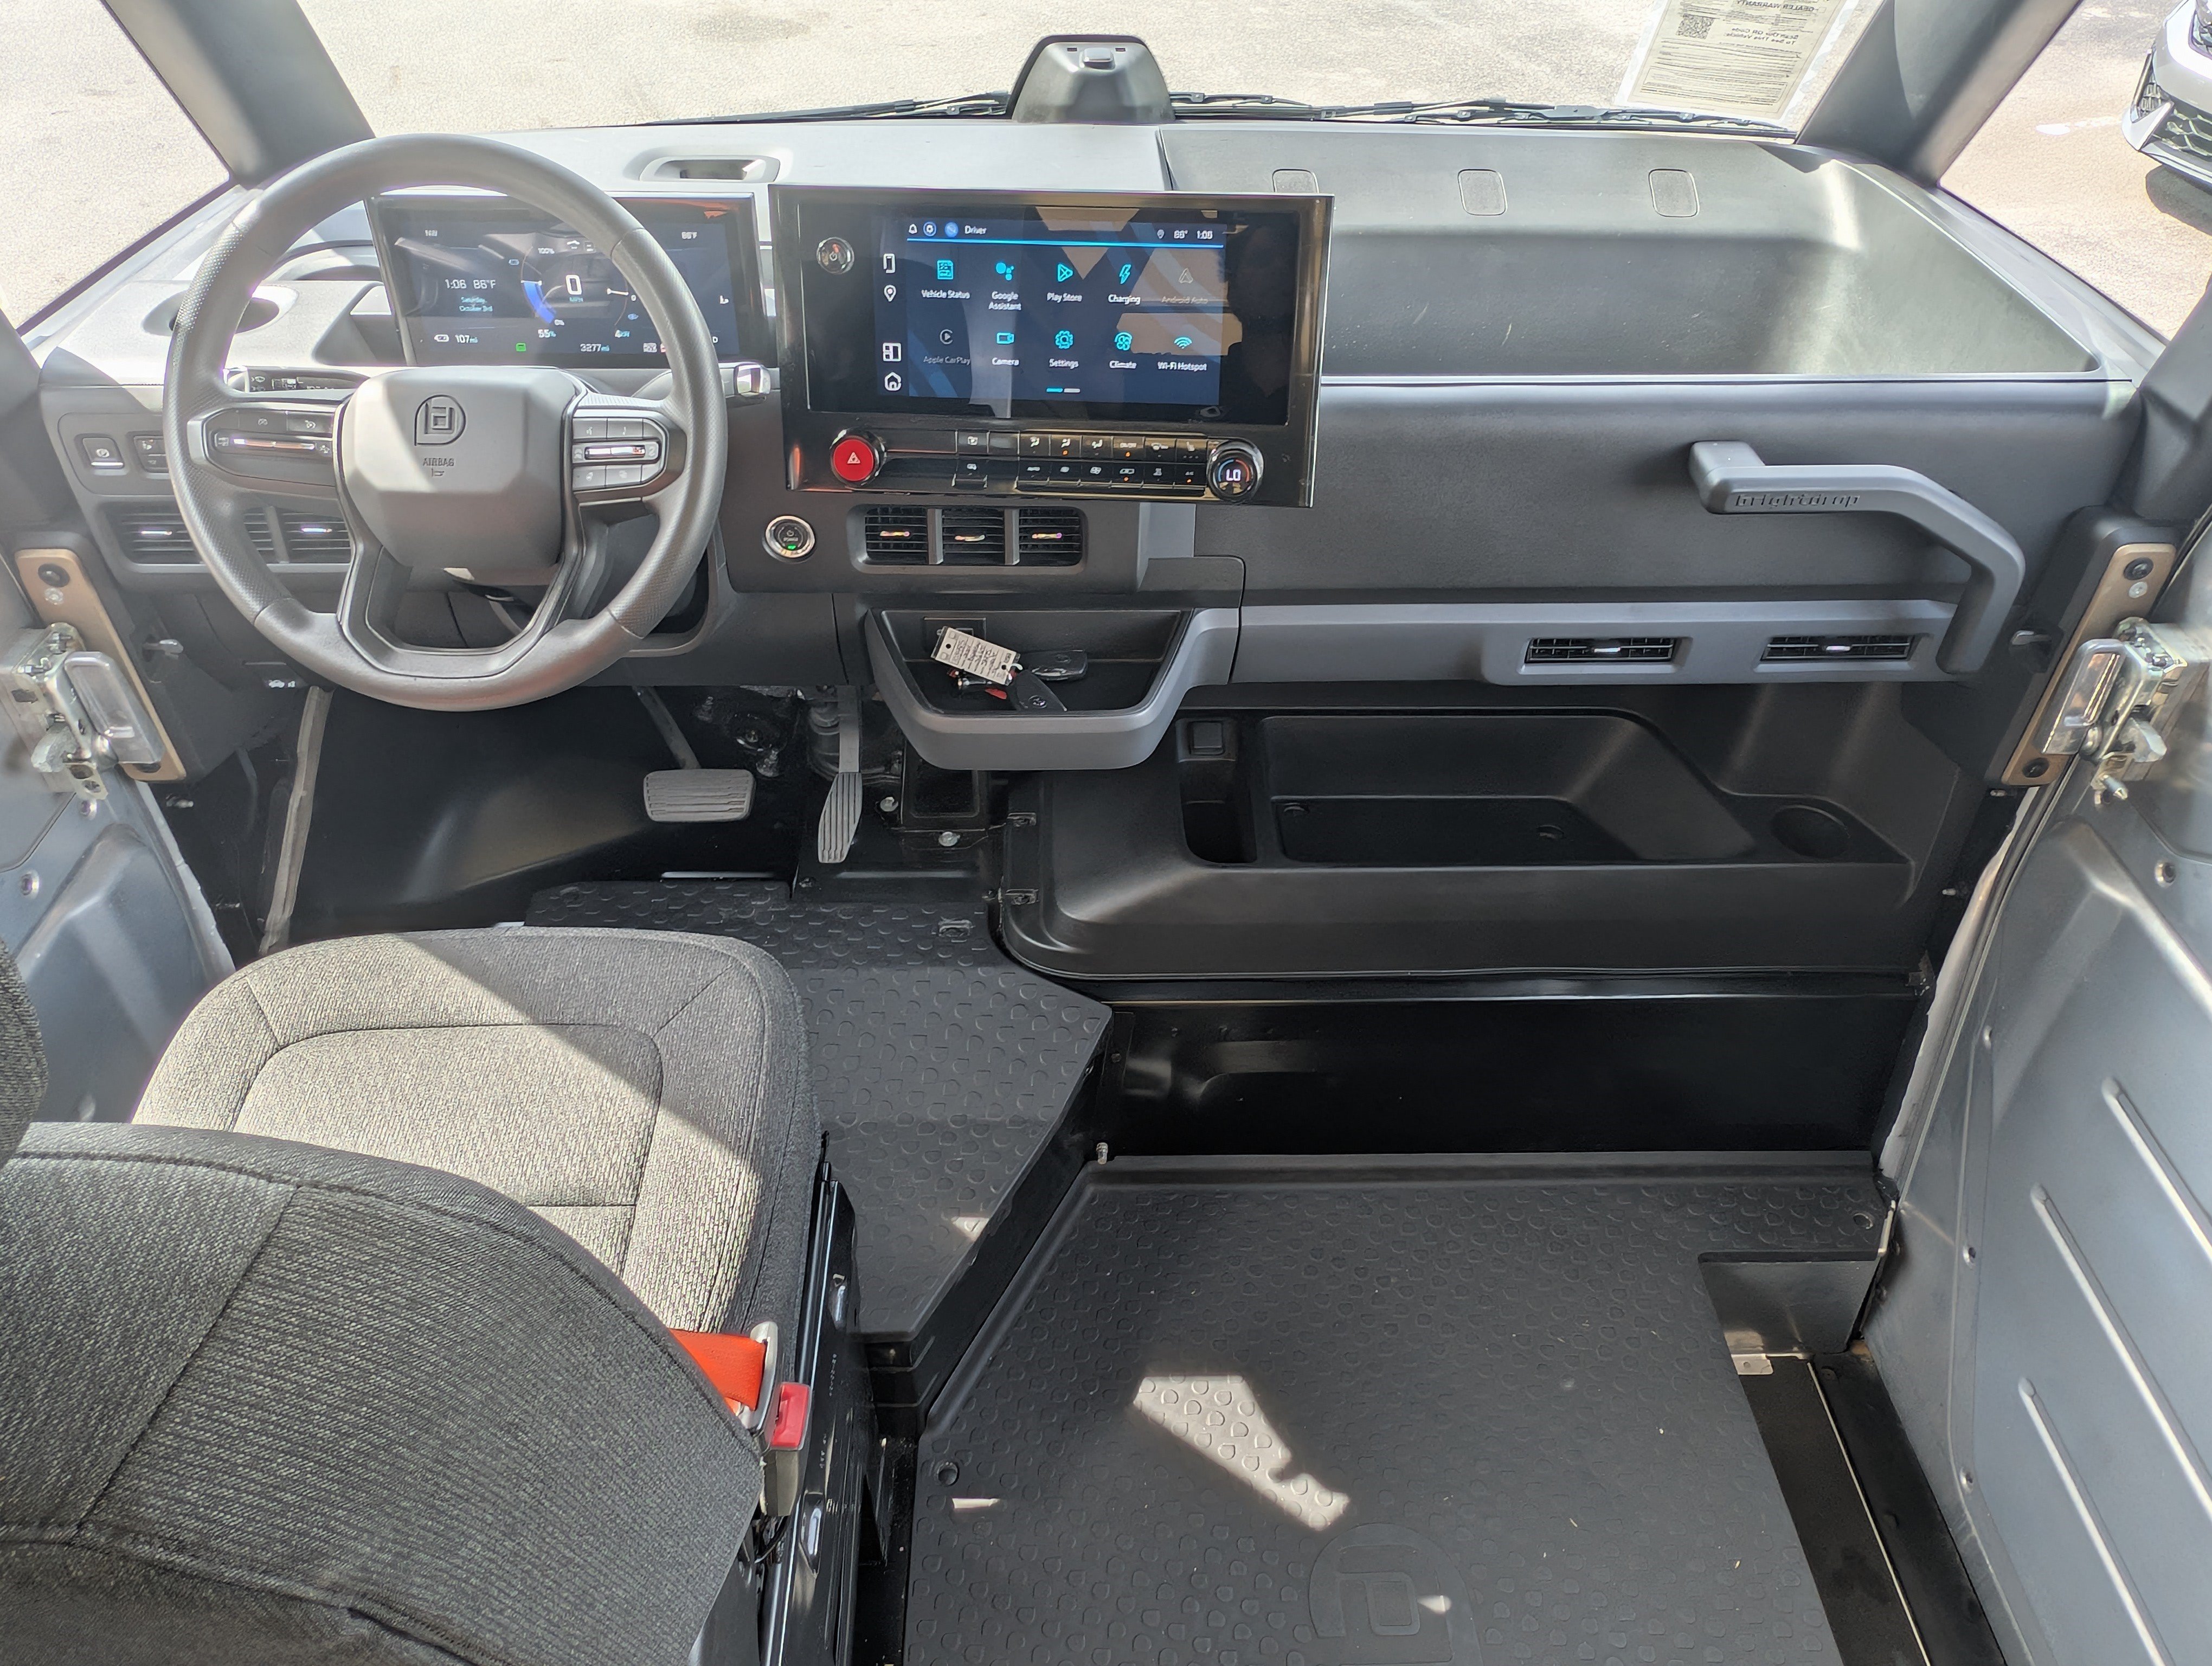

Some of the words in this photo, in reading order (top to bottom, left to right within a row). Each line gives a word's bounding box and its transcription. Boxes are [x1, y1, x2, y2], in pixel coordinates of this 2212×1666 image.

[964, 225, 987, 234] Driver
[445, 279, 467, 289] 1:06
[565, 274, 582, 295] 0
[921, 290, 947, 298] Vehicle
[947, 290, 970, 299] Status
[992, 291, 1018, 302] Google
[1047, 292, 1062, 303] Play
[1063, 293, 1082, 302] Store
[1108, 294, 1141, 305] Charging
[988, 302, 1022, 310] Assistant
[923, 356, 943, 364] Apple
[944, 356, 970, 366] CarPlay
[992, 357, 1020, 366] Camera
[1049, 358, 1079, 370] Settings
[1109, 360, 1137, 369] Climate
[1158, 361, 1176, 369] Wi-Fi
[1178, 362, 1207, 372] Hotspot
[422, 457, 455, 467] AIRBAG
[1226, 469, 1242, 482] LO
[1735, 493, 1861, 508] brightdrop
